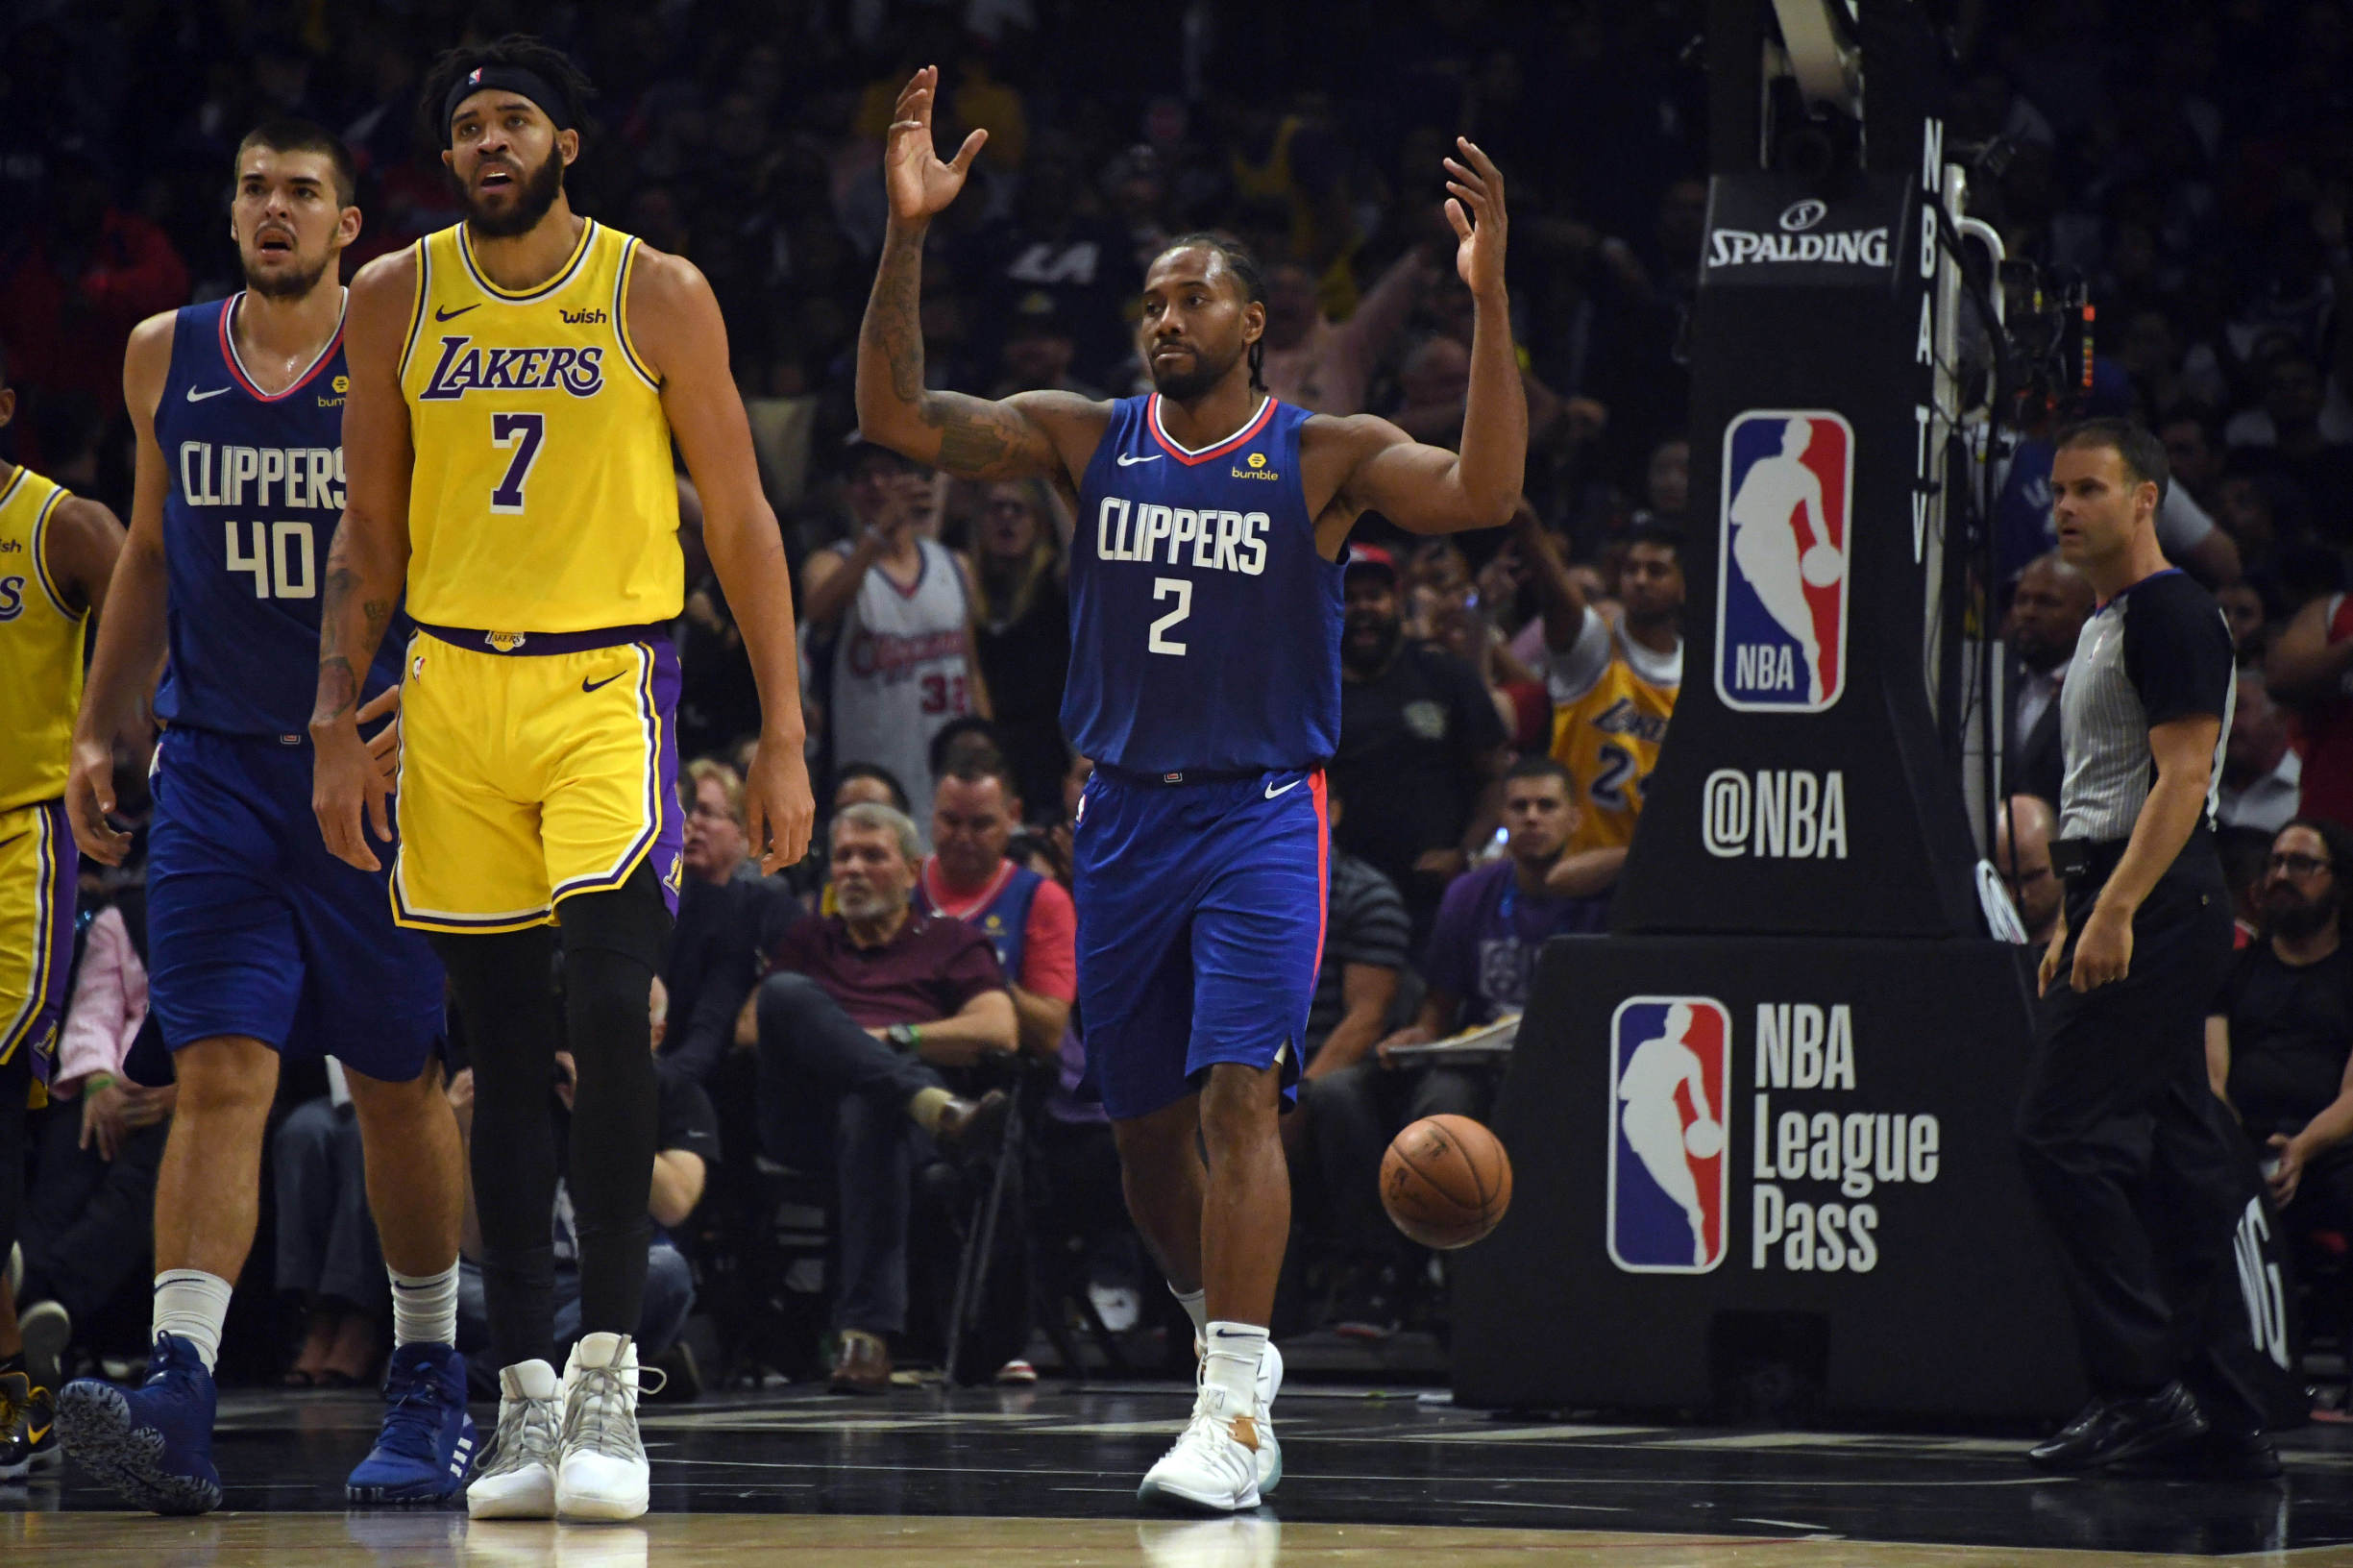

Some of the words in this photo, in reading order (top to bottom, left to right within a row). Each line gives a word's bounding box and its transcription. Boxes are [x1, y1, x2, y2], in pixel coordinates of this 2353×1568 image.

[1707, 227, 1889, 268] SPALDING
[559, 307, 607, 324] wish
[317, 395, 346, 407] bum
[419, 334, 606, 401] LAKERS
[489, 411, 546, 515] 7
[1231, 466, 1279, 481] bumble
[225, 520, 317, 600] 40
[1097, 496, 1270, 576] CLIPPERS
[1148, 576, 1193, 656] 2
[1734, 643, 1795, 691] NBA
[1702, 769, 1849, 859] @NBA
[1754, 1002, 1857, 1090] NBA
[1753, 1093, 1940, 1199] League
[1752, 1184, 1878, 1273] Pass
